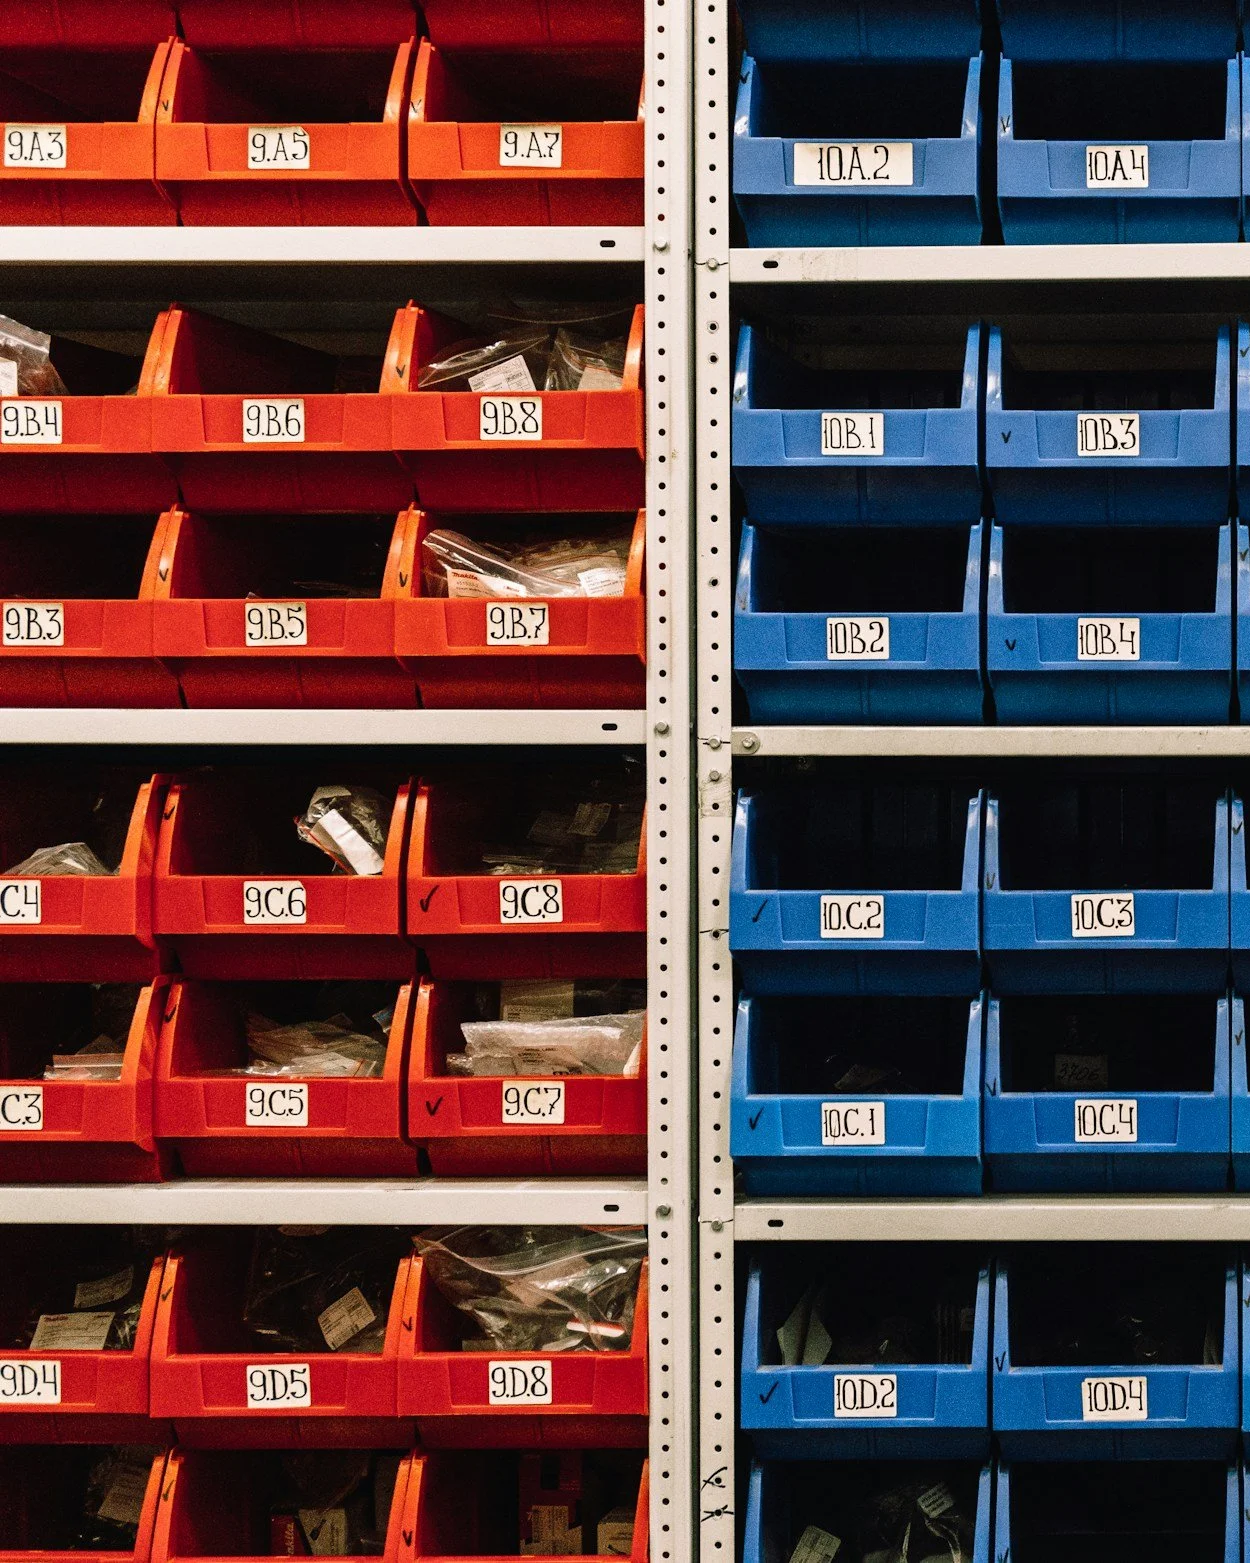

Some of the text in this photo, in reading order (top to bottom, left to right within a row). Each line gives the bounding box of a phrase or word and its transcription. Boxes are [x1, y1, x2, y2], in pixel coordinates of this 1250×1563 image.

[8, 131, 64, 161] 9.A.3
[251, 131, 308, 163] 9.A.5
[504, 131, 560, 158] 9.A.7
[817, 146, 890, 181] 10.A.2
[1088, 149, 1145, 181] 10.A.4
[246, 404, 301, 437] 9.B.6
[482, 401, 539, 435] 9.B.8
[824, 417, 876, 449] 10.B.1
[1080, 418, 1137, 452] 10.B.3
[6, 607, 62, 641] 9.B.3
[247, 606, 305, 641] 9.B.5
[489, 606, 547, 640] 9.B.7
[829, 621, 884, 654] 10.B.2
[1080, 622, 1136, 656] 10.B.4
[0, 884, 39, 918] C.4
[245, 886, 306, 918] 9.C.6
[502, 884, 560, 919] 9.C.8
[823, 900, 882, 931] 10.C.2
[1074, 898, 1133, 931] 10.C.3
[0, 1093, 42, 1126] C.3
[249, 1088, 304, 1117] 9.C.5
[504, 1086, 562, 1117] 9.C.7
[824, 1108, 875, 1139] 10.C.1
[1077, 1103, 1135, 1137] 10.C.4
[0, 1364, 58, 1397] 9.D.4
[249, 1368, 308, 1402] 9.D.5
[491, 1365, 548, 1398] 9.D.8
[836, 1378, 895, 1411] 10.D.2
[1087, 1380, 1144, 1412] 10.D.4
